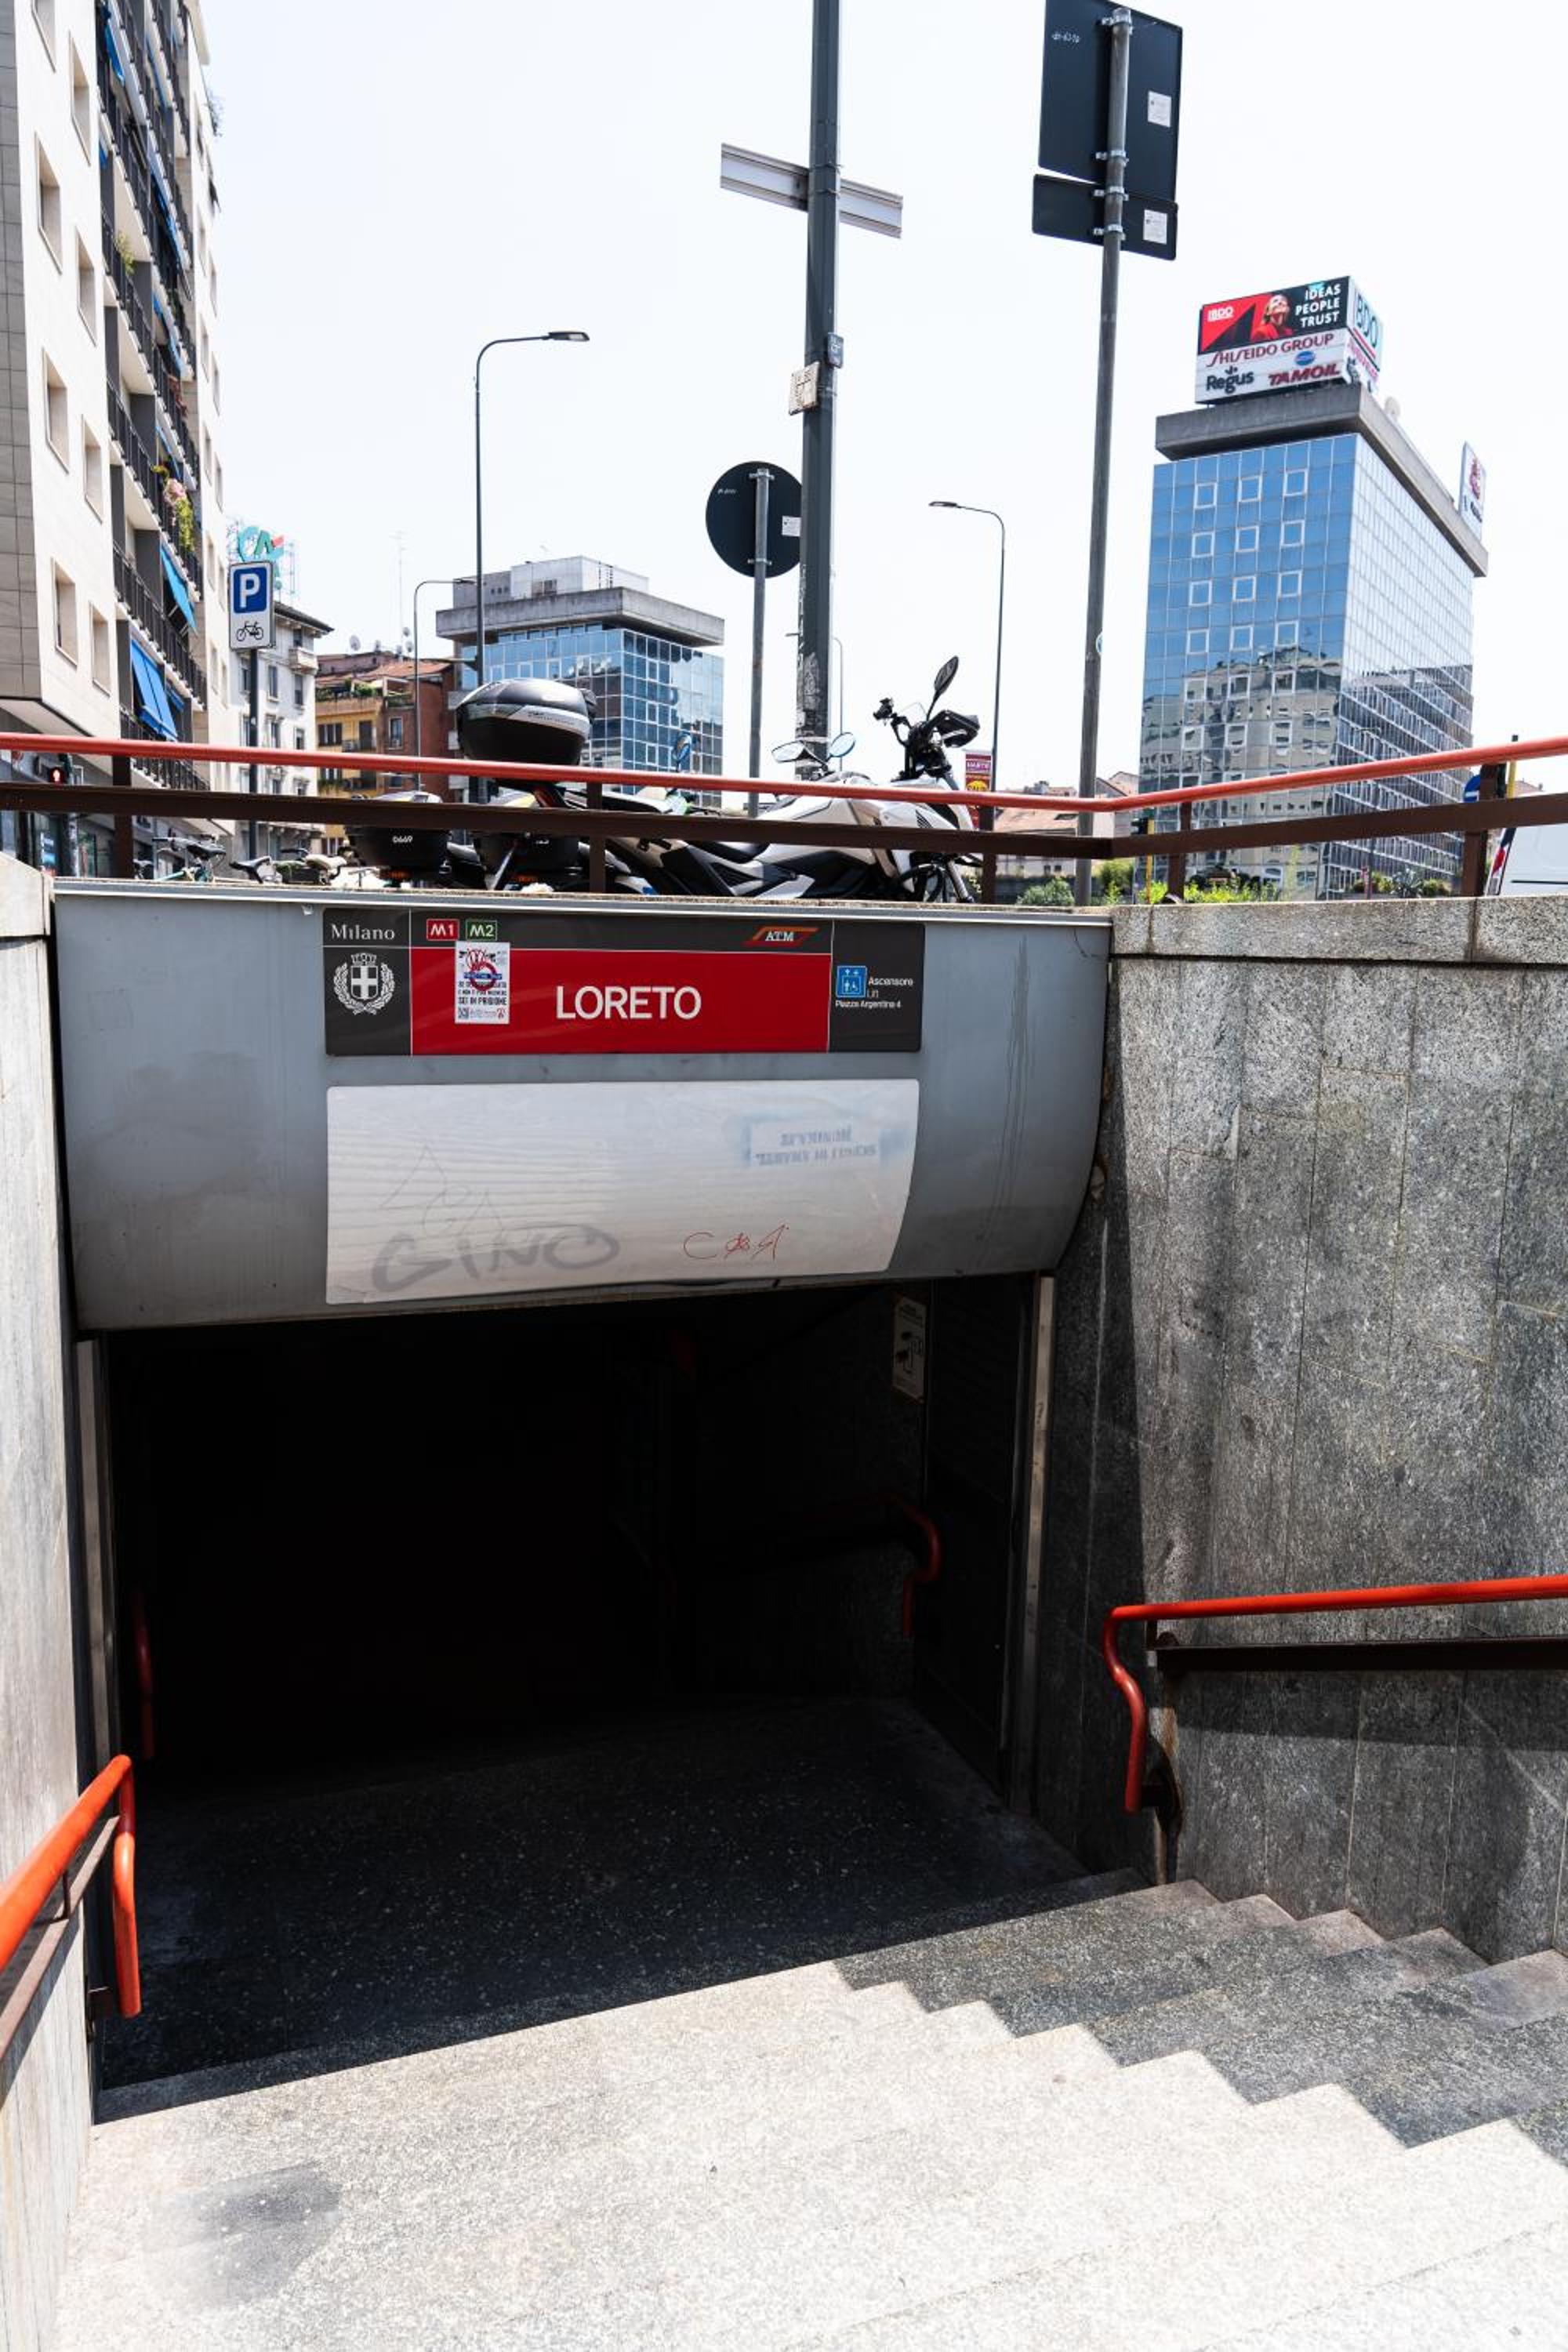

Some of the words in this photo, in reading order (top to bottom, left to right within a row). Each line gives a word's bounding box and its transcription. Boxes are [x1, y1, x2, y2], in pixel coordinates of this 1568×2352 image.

[1305, 284, 1341, 301] IDEAS
[1295, 298, 1340, 316] PEOPLE
[1300, 312, 1340, 328] TRUST
[1206, 344, 1277, 368] SHISEIDO
[1280, 333, 1334, 351] GROUP
[1206, 372, 1254, 394] Regus
[1268, 363, 1340, 386] TAMOIL
[239, 573, 260, 608] P
[331, 924, 395, 940] Milano
[430, 924, 454, 937] M1
[470, 924, 495, 937] M2
[765, 931, 794, 942] ATM
[868, 976, 913, 986] Ascensore
[557, 985, 702, 1019] LORETO
